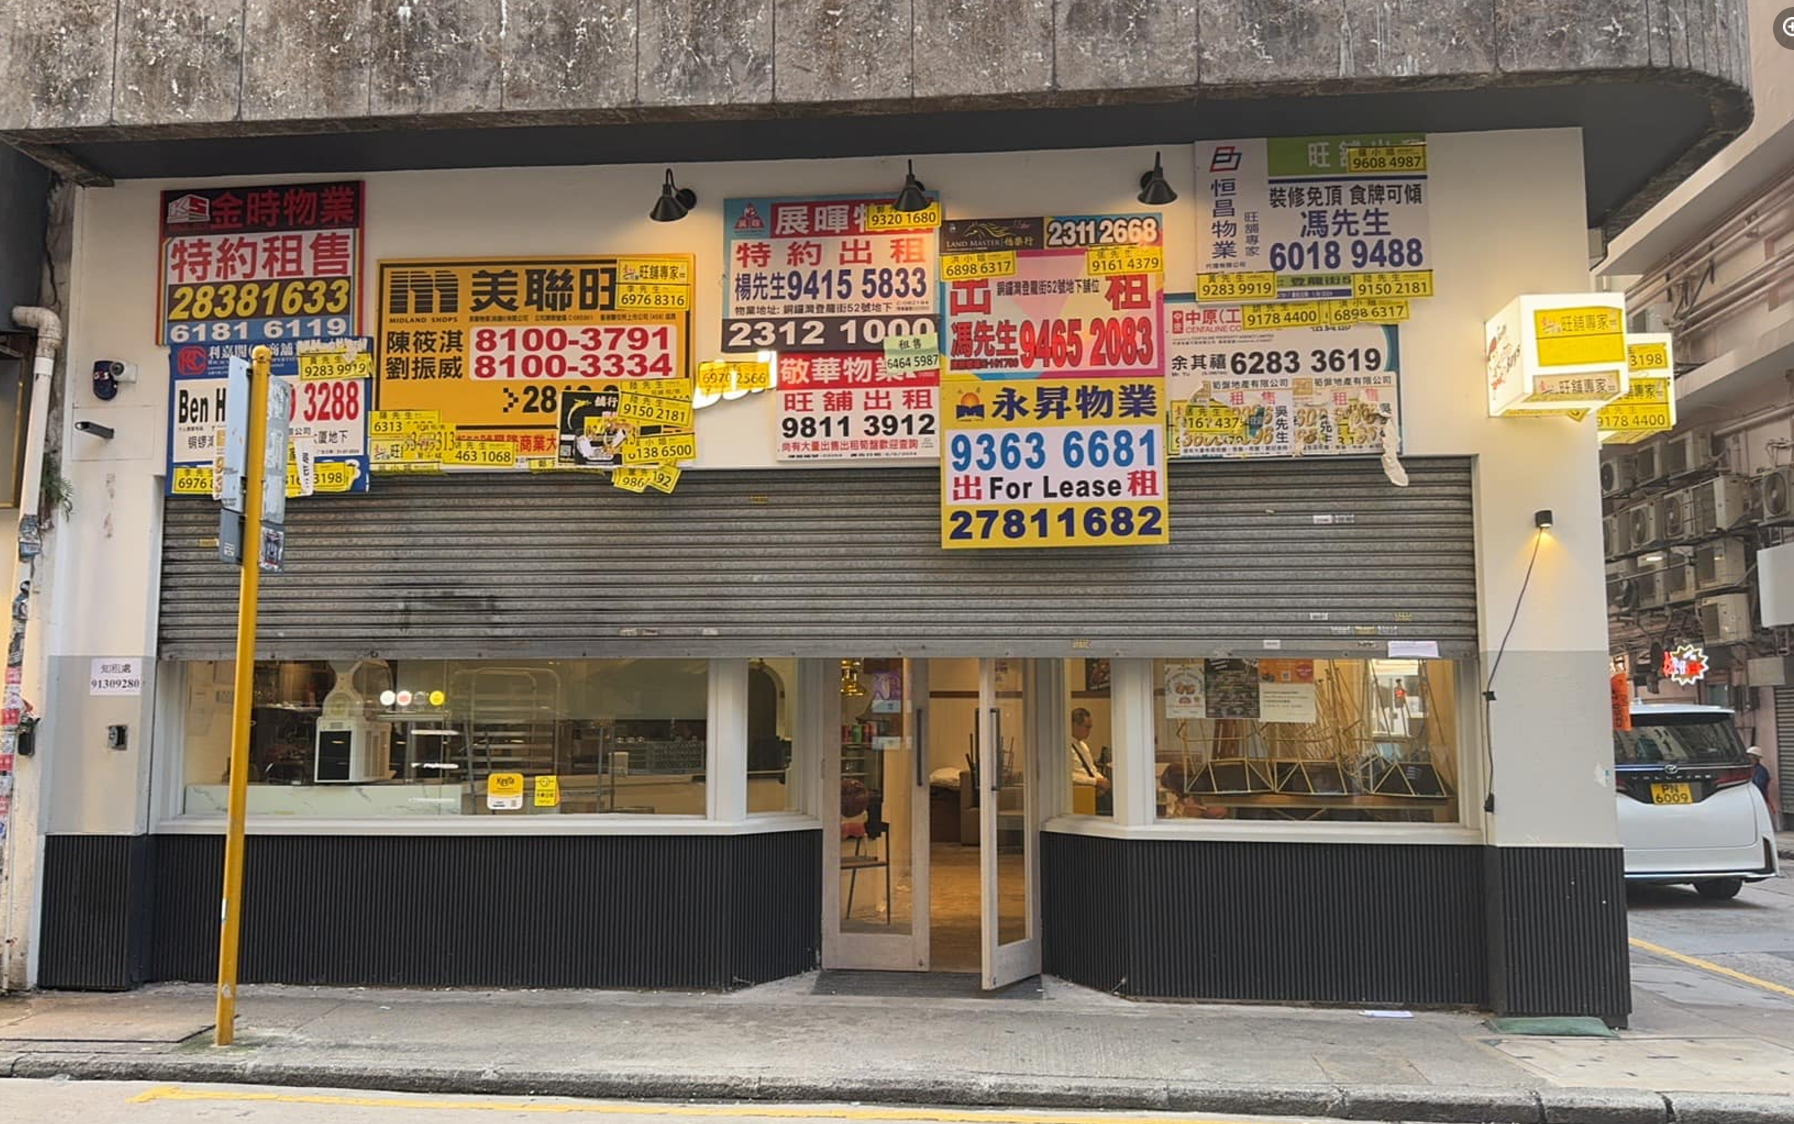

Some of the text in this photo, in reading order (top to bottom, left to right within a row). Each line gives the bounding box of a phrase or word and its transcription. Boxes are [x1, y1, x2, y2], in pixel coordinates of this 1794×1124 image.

[1353, 156, 1421, 169] 9608 4987
[1269, 184, 1422, 208] 裝修免頂 食牌可傾
[211, 186, 354, 229] 金時物業
[872, 212, 936, 226] 9320 1680
[1210, 178, 1237, 259] 恒昌物業
[1300, 208, 1391, 238] 馮先生
[1048, 217, 1158, 247] 2311 2668
[969, 239, 1000, 247] MASTER
[170, 232, 350, 283] 特約租售
[736, 238, 926, 268] 特約出租
[1270, 238, 1423, 271] 6018 9488
[946, 261, 1011, 276] 6898 6317
[1092, 257, 1159, 271] 9161 4379
[470, 269, 617, 311] 美聯旺
[735, 267, 926, 301] 楊先生 9415 5833
[1203, 283, 1271, 295] 9283 9919
[1358, 282, 1427, 295] 9150 2181
[168, 279, 350, 320] 28381633
[621, 294, 685, 306] 6976 8316
[950, 279, 991, 316] 出
[1105, 274, 1151, 311] 租
[1186, 308, 1242, 325] 中原(工
[1247, 310, 1317, 326] 9178 4400
[1334, 306, 1404, 321] 6898 6317
[170, 318, 347, 343] 6181 6119
[729, 320, 824, 346] 2312
[1186, 325, 1228, 334] CENTALINE
[476, 327, 668, 352] 8100-3791
[899, 338, 922, 350] 租售
[951, 320, 1018, 357] 馮先生
[1020, 319, 1083, 369] 9465
[1089, 316, 1153, 366] 2083
[386, 356, 463, 379] 劉振威
[475, 353, 672, 378] 8100-3334
[887, 357, 911, 369] 6464
[914, 354, 938, 367] 5987
[1230, 351, 1300, 375] 6283
[1311, 348, 1382, 372] 3619
[1630, 353, 1663, 366] 3198
[305, 363, 366, 376] 9283 9919
[737, 372, 766, 384] 2566
[178, 390, 208, 424] Ben
[303, 381, 359, 422] 3288
[784, 389, 933, 412] 旺舖出租
[991, 384, 1157, 421] 永昇物業
[623, 403, 685, 422] 9150 2181
[1597, 414, 1665, 427] 9178 4400
[374, 421, 402, 432] 6313
[782, 414, 935, 438] 9811 3912
[454, 451, 511, 462] 463 1068
[662, 444, 692, 456] 6500
[952, 431, 1046, 472] 9363
[1063, 429, 1155, 468] 6681
[178, 478, 207, 489] 6976
[313, 472, 342, 484] 3198
[622, 476, 644, 488] 986
[653, 470, 672, 487] 192
[953, 470, 1159, 500] 出 For Lease 租
[950, 506, 1162, 540] 27811682
[91, 678, 140, 689] 91309280
[1662, 784, 1679, 794] PN
[1656, 793, 1689, 804] 6009
